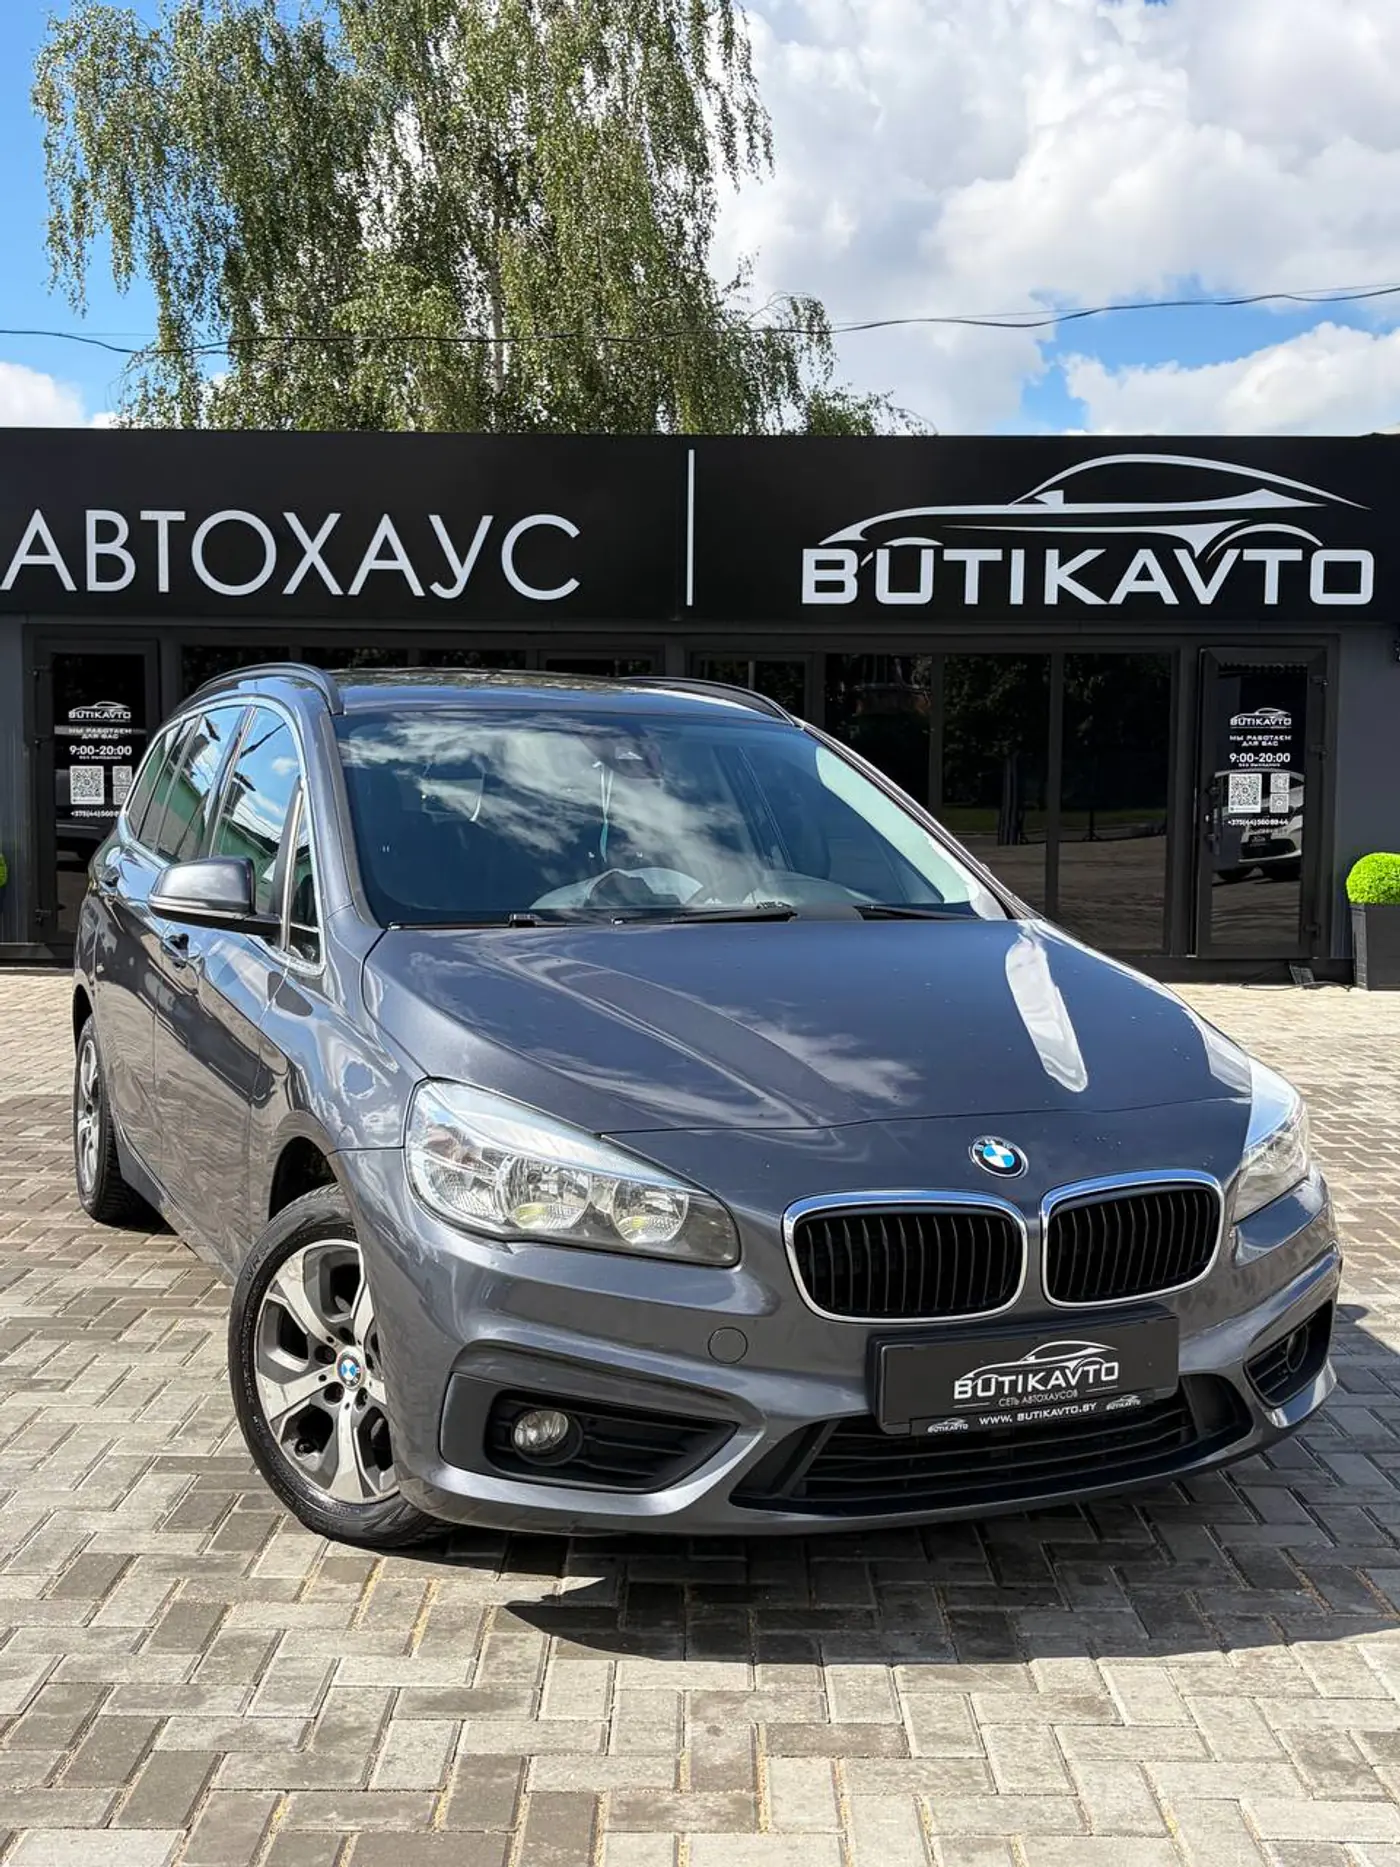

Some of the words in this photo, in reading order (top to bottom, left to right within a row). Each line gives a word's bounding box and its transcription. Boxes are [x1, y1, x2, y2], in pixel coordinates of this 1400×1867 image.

[0, 509, 580, 600] АВТОХАУС
[802, 548, 1374, 605] BUTIKAVTO
[68, 711, 132, 719] BUTIKAVTO
[1230, 718, 1291, 726] BUTIKAVTO
[69, 745, 132, 756] 9:00-20:00
[1229, 752, 1291, 764] 9:00-20:00
[954, 1362, 1119, 1400] BUTIKAVTO
[979, 1414, 1013, 1425] WWW.
[1017, 1402, 1097, 1421] BUTIKAVTO.BY
